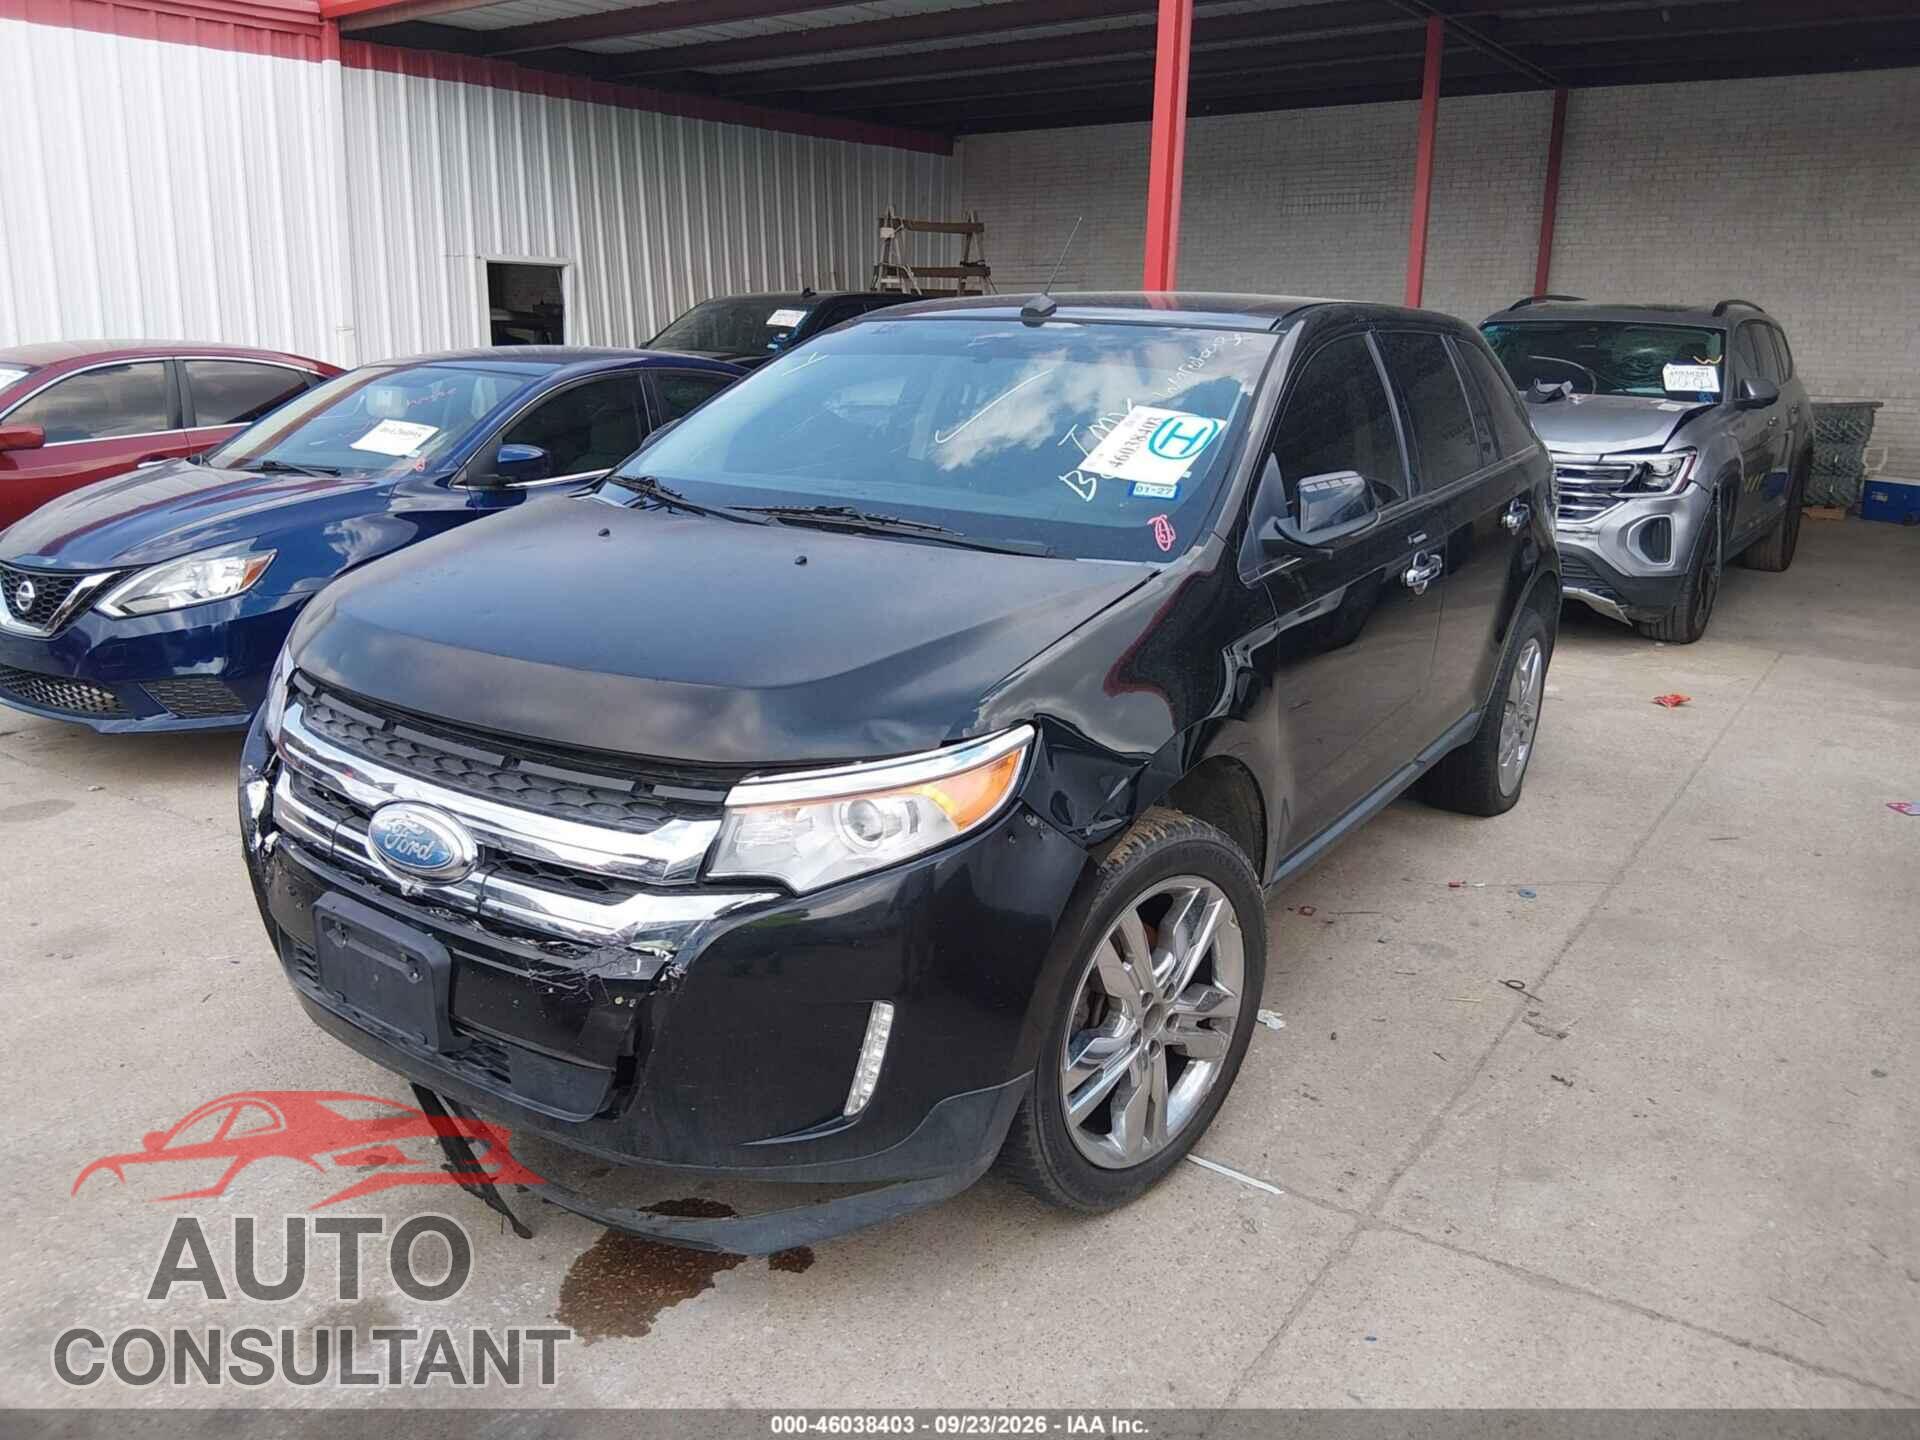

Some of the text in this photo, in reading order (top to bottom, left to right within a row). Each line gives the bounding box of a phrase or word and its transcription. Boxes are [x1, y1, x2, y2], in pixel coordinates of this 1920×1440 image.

[1158, 421, 1209, 455] H
[1135, 485, 1174, 496] 01-27
[384, 820, 435, 861] Ford
